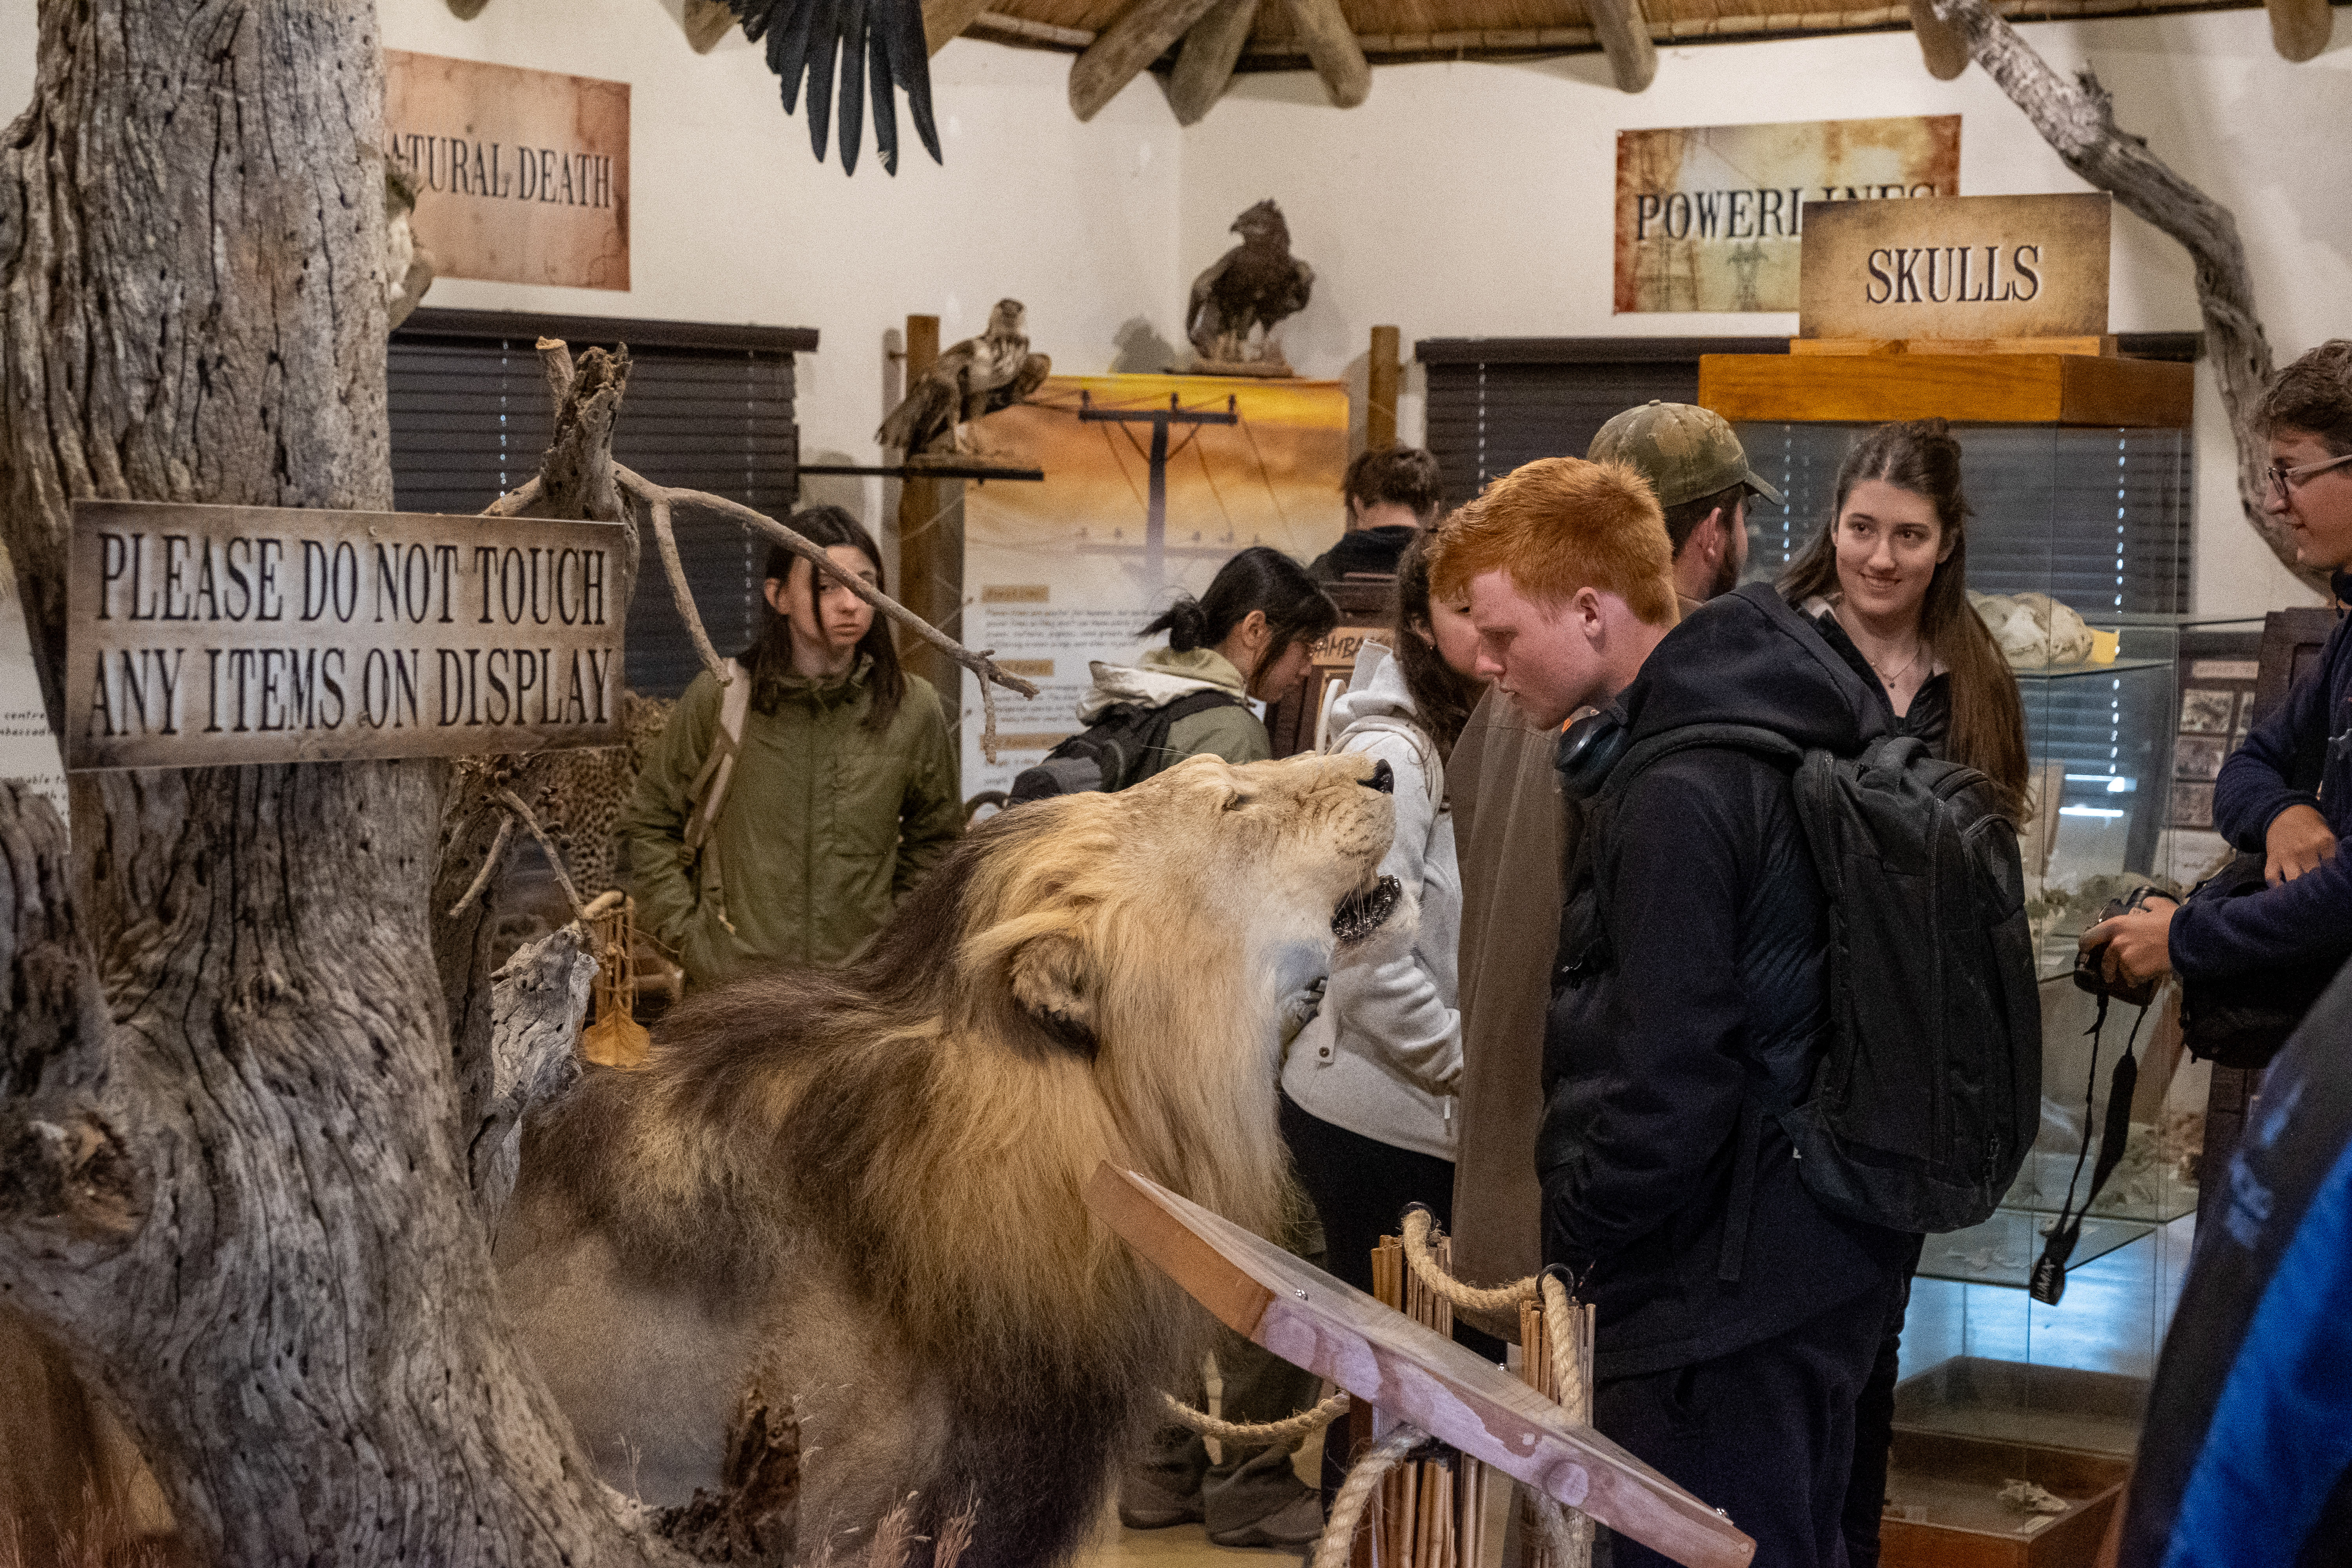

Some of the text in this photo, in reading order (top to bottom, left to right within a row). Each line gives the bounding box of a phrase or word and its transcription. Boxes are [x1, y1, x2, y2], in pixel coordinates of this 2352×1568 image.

[518, 146, 611, 208] DEATH
[1867, 245, 2038, 304] SKULLS
[96, 532, 605, 625] PLEASE DO NOT TOUCH
[85, 647, 612, 738] ANY ITEMS ON DISPLAY
